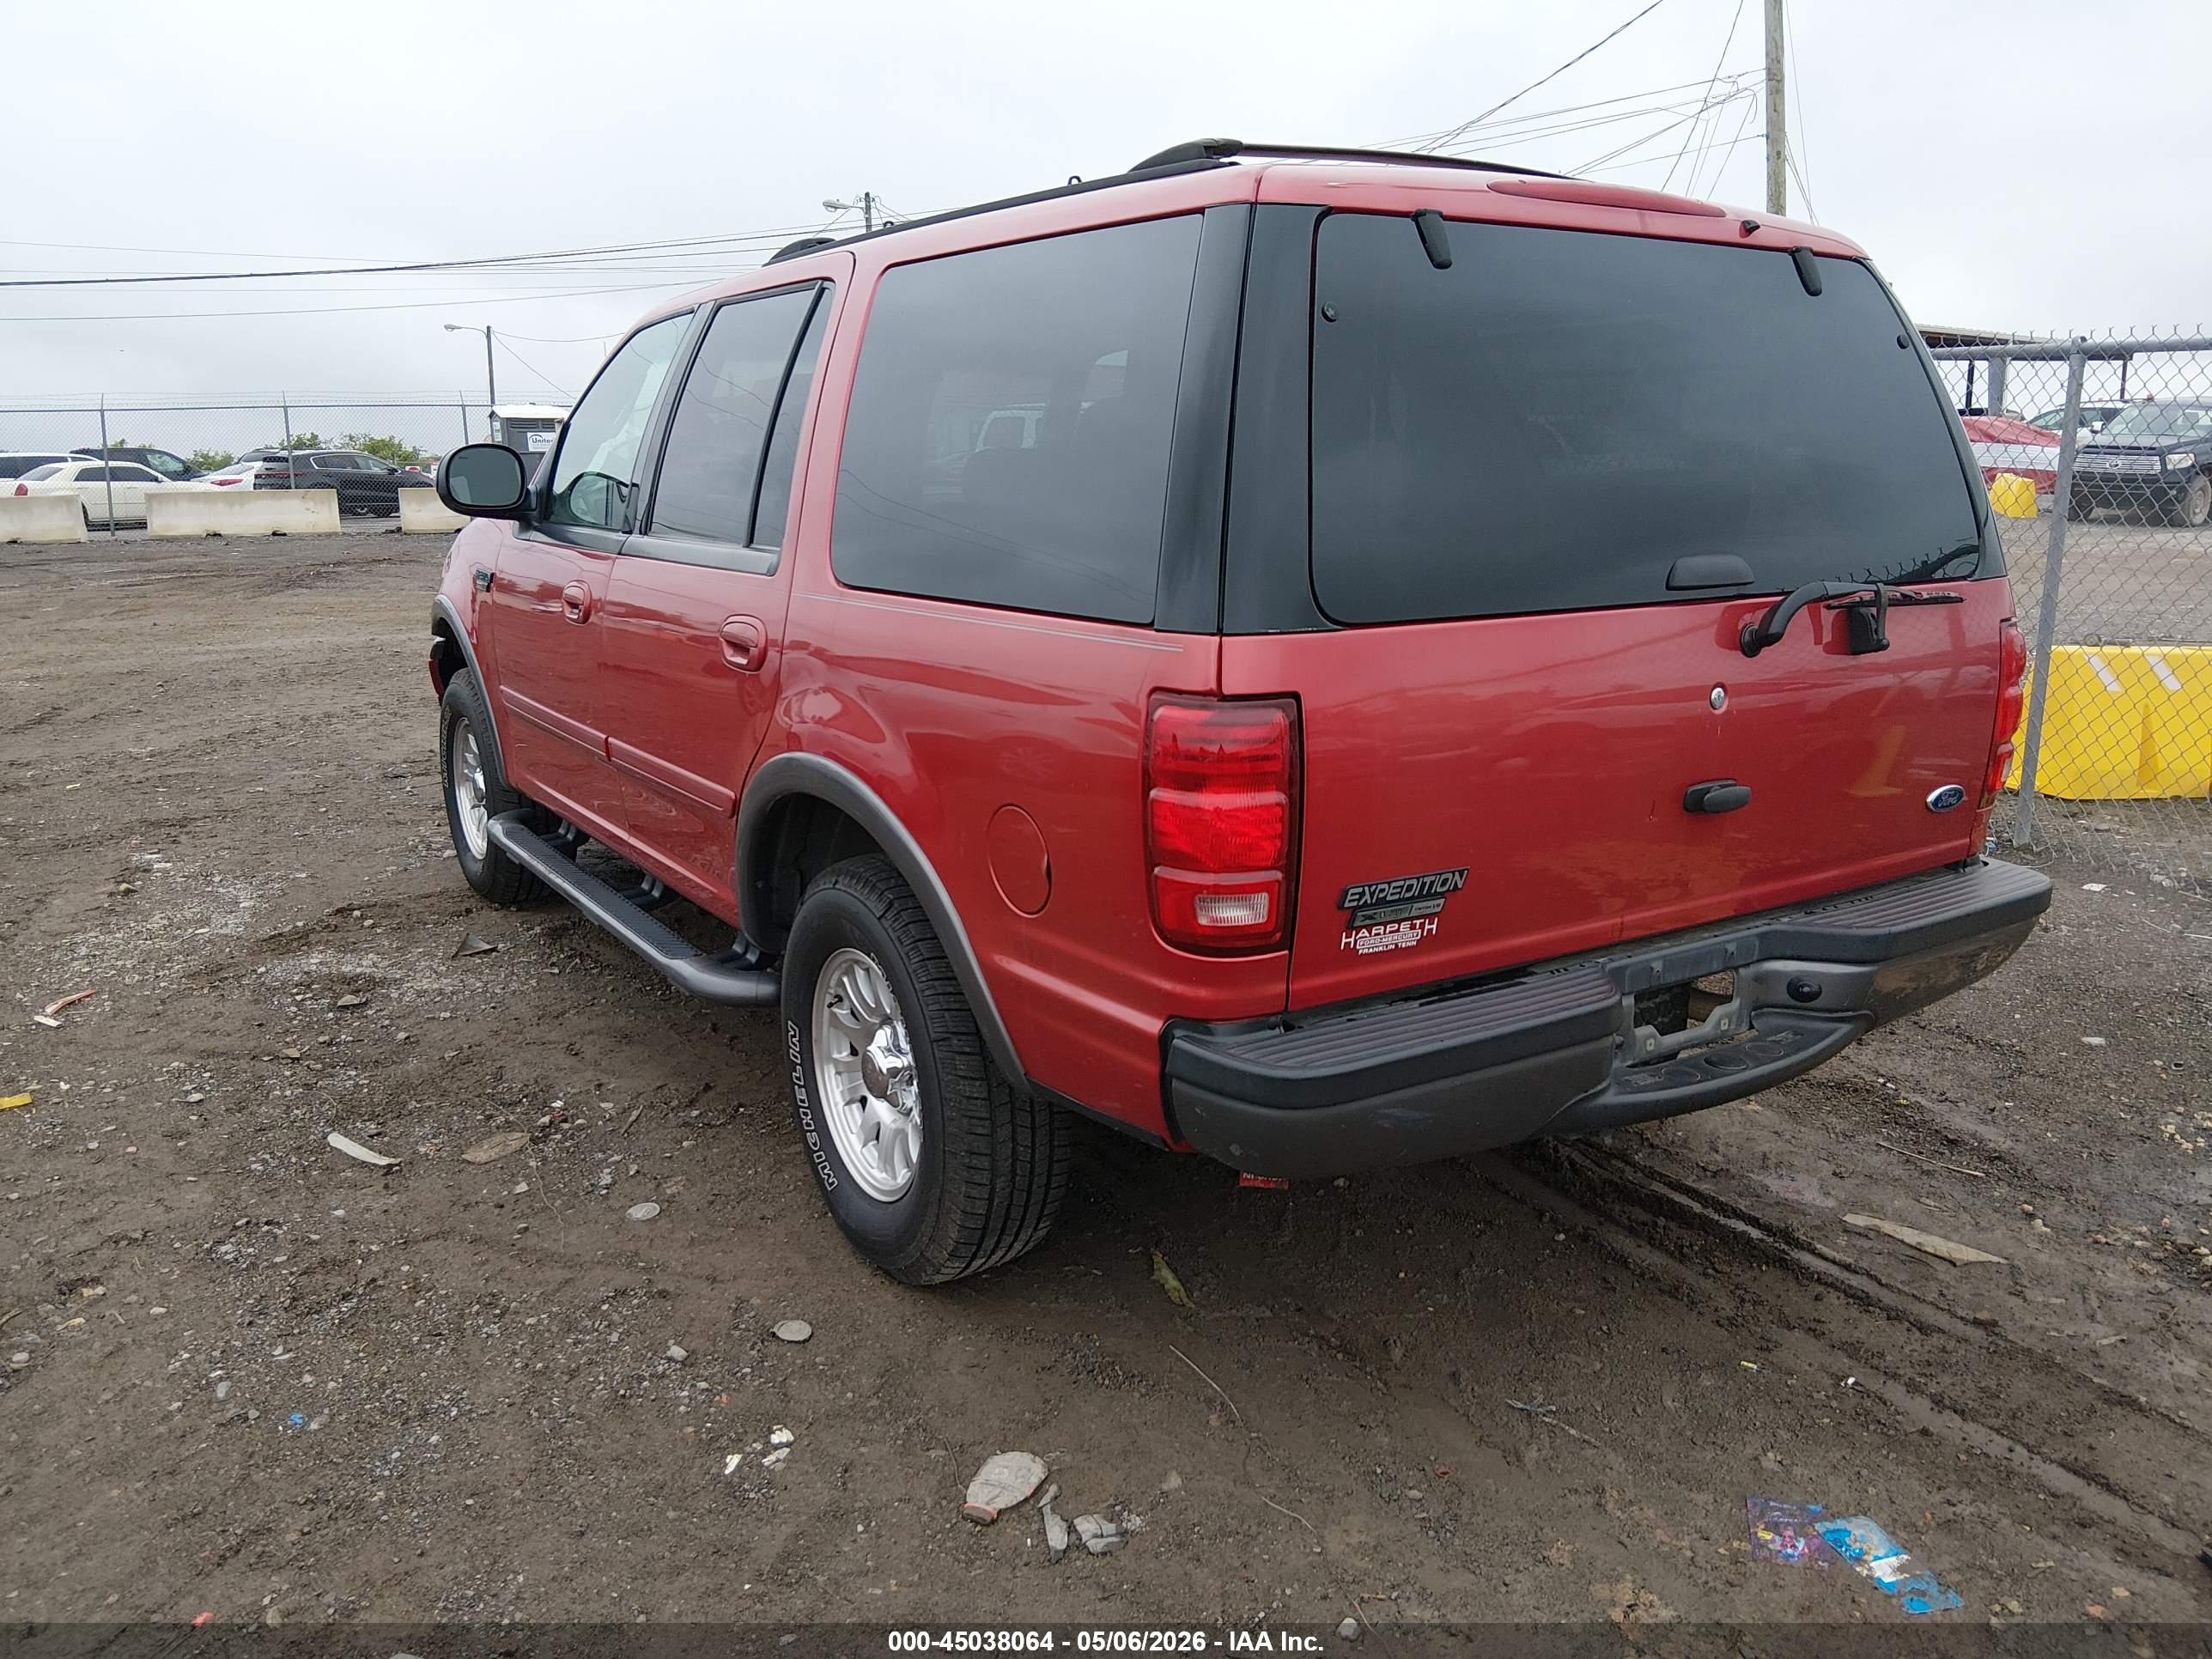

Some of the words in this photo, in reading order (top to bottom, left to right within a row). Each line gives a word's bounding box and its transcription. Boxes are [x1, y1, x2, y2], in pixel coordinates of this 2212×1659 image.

[1938, 791, 1959, 807] Ford
[1344, 870, 1468, 908] EXPEDITION
[1340, 917, 1438, 950] HARPETH
[1359, 932, 1418, 945] FORD-MERCURY
[1358, 944, 1395, 955] FRANKLIN
[1398, 940, 1417, 949] TENN
[787, 1020, 838, 1191] MICHELIN
